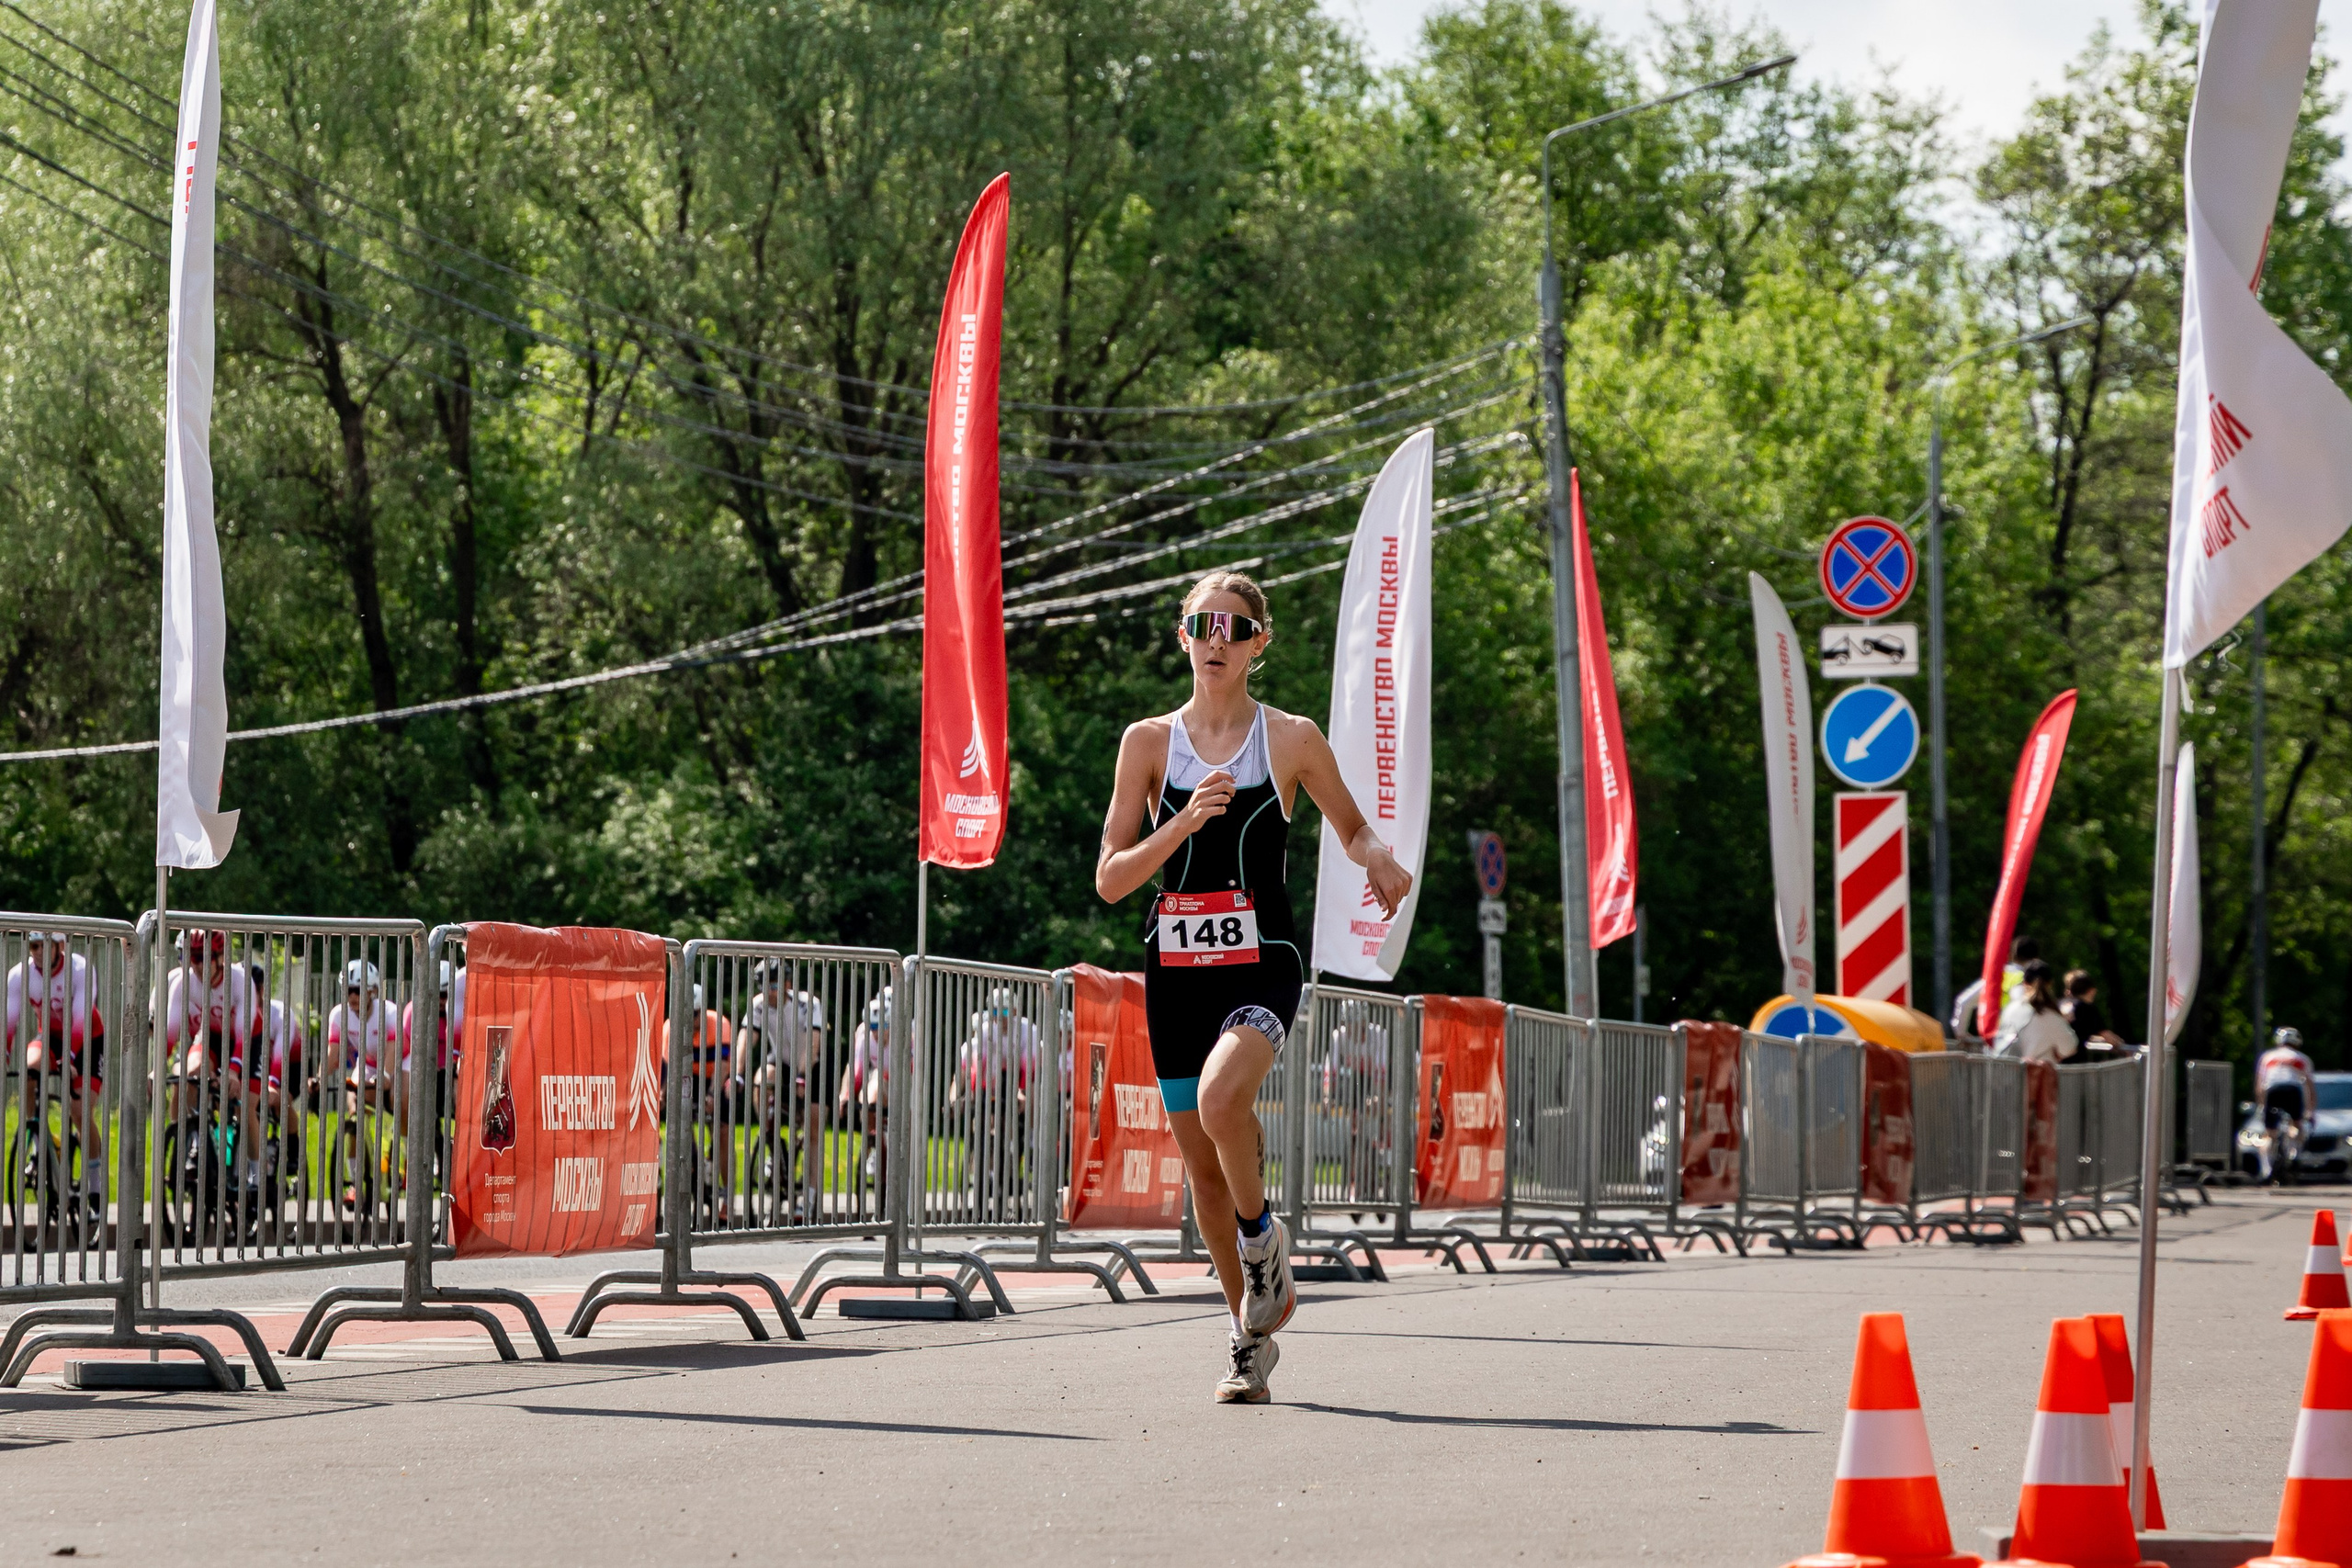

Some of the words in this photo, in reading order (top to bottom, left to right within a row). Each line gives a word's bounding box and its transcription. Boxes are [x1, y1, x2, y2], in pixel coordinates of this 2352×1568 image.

[953, 313, 977, 455] МОСКВЫ
[1376, 536, 1398, 648] МОСКВЫ
[1374, 657, 1396, 819] ПЕРВЕНСТВО
[956, 818, 987, 838] СПОРТ
[1171, 917, 1244, 949] 148
[540, 1075, 616, 1131] ПЕРВЕНСТВО
[484, 1172, 517, 1188] Департамент
[551, 1156, 605, 1213] МОСКВЫ
